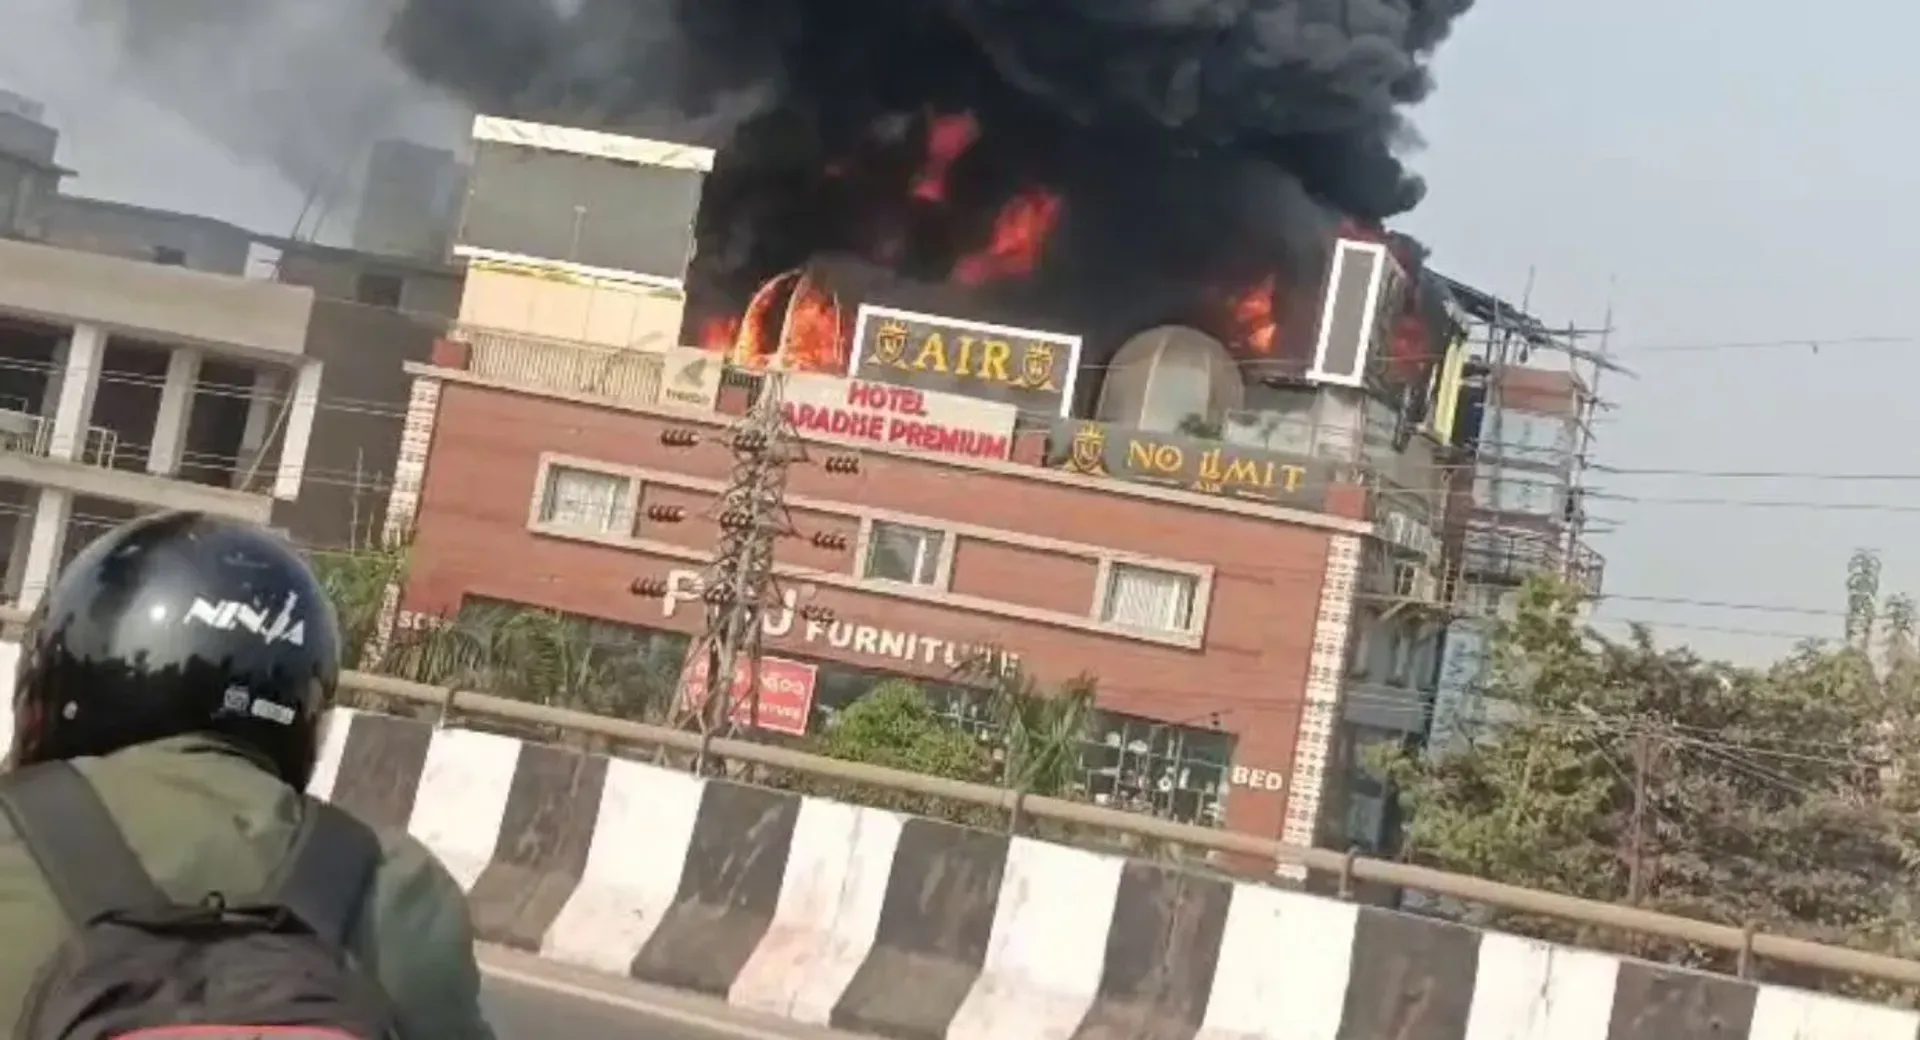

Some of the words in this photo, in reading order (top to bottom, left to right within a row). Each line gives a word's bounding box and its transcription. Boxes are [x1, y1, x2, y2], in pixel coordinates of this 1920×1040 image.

[911, 332, 1011, 381] AIR
[846, 381, 928, 417] HOTEL
[774, 399, 885, 442] ARADISE
[888, 418, 1008, 460] PREMIUM
[1127, 439, 1184, 472] NO
[182, 589, 305, 646] NINJA
[1231, 764, 1284, 791] BED
